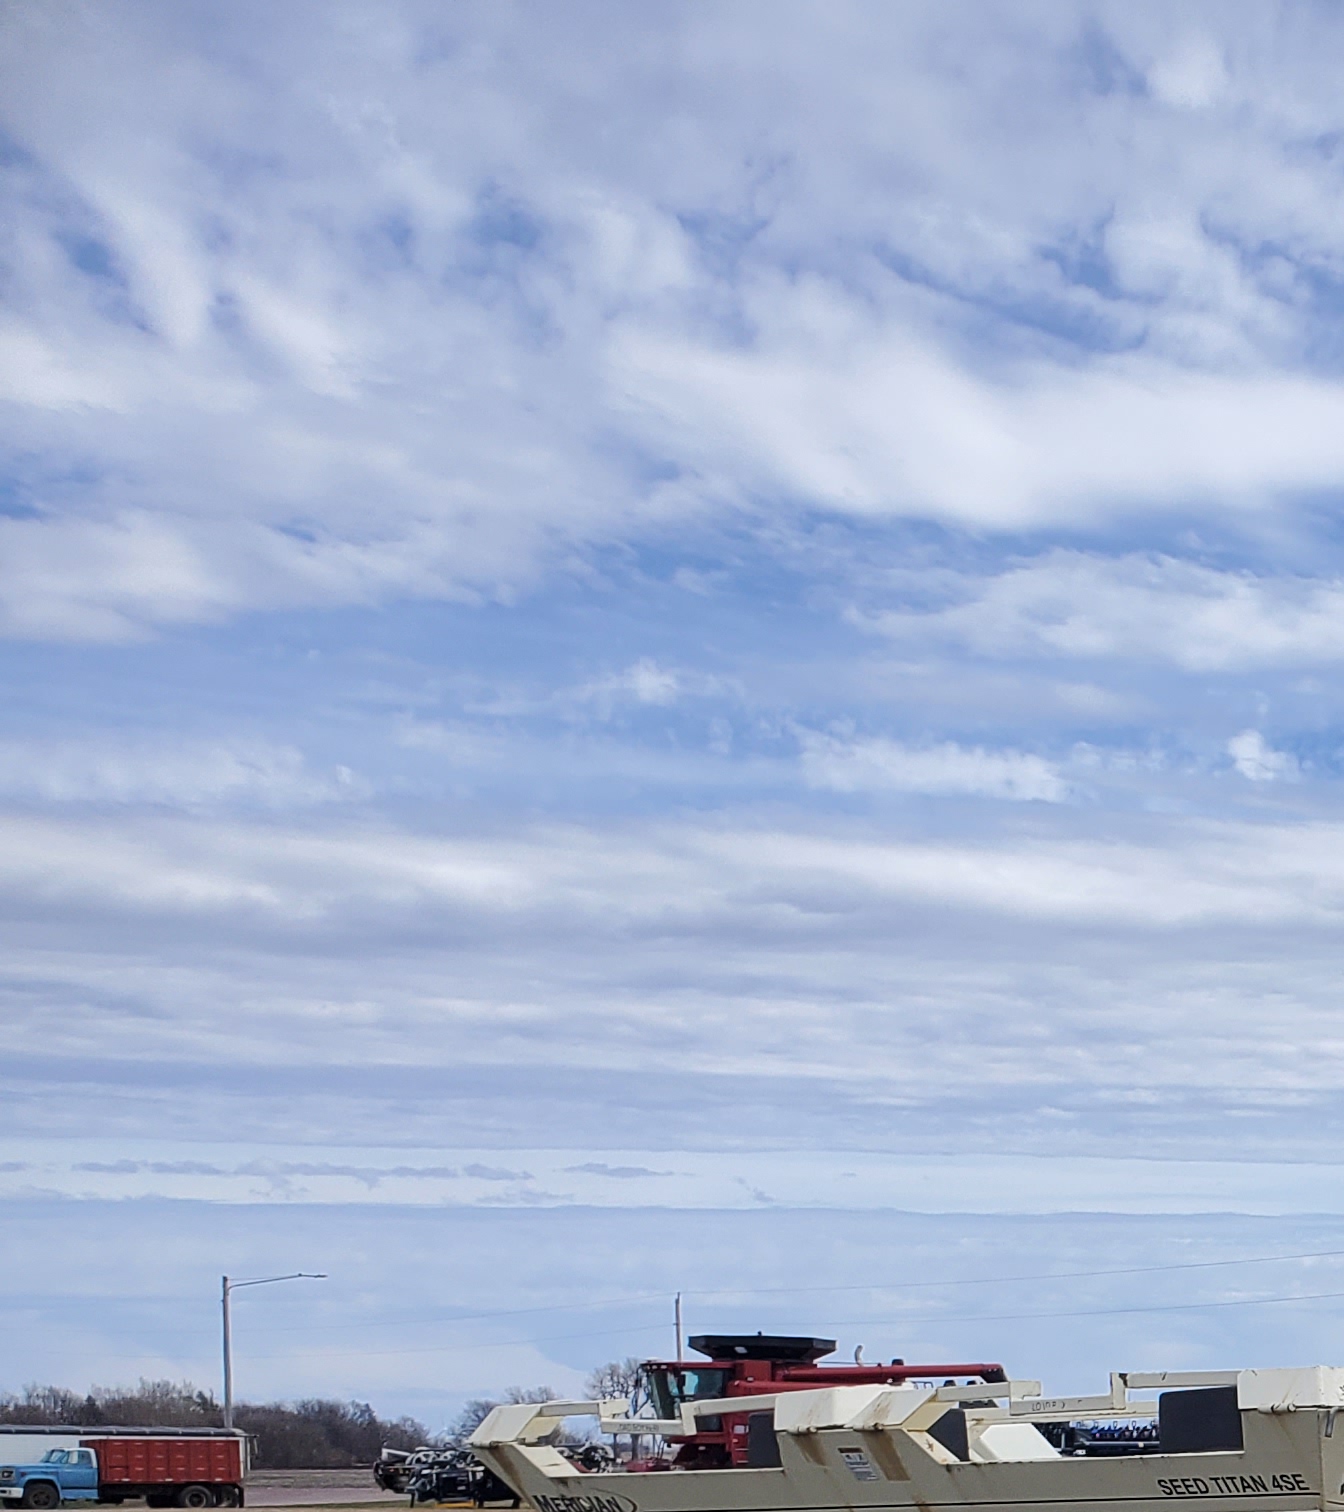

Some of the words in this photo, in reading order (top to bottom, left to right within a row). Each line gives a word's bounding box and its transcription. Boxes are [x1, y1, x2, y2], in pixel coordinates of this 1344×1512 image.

[1157, 1477, 1210, 1496] SEED
[1209, 1475, 1269, 1494] TITAN
[1271, 1473, 1310, 1492] 4SE
